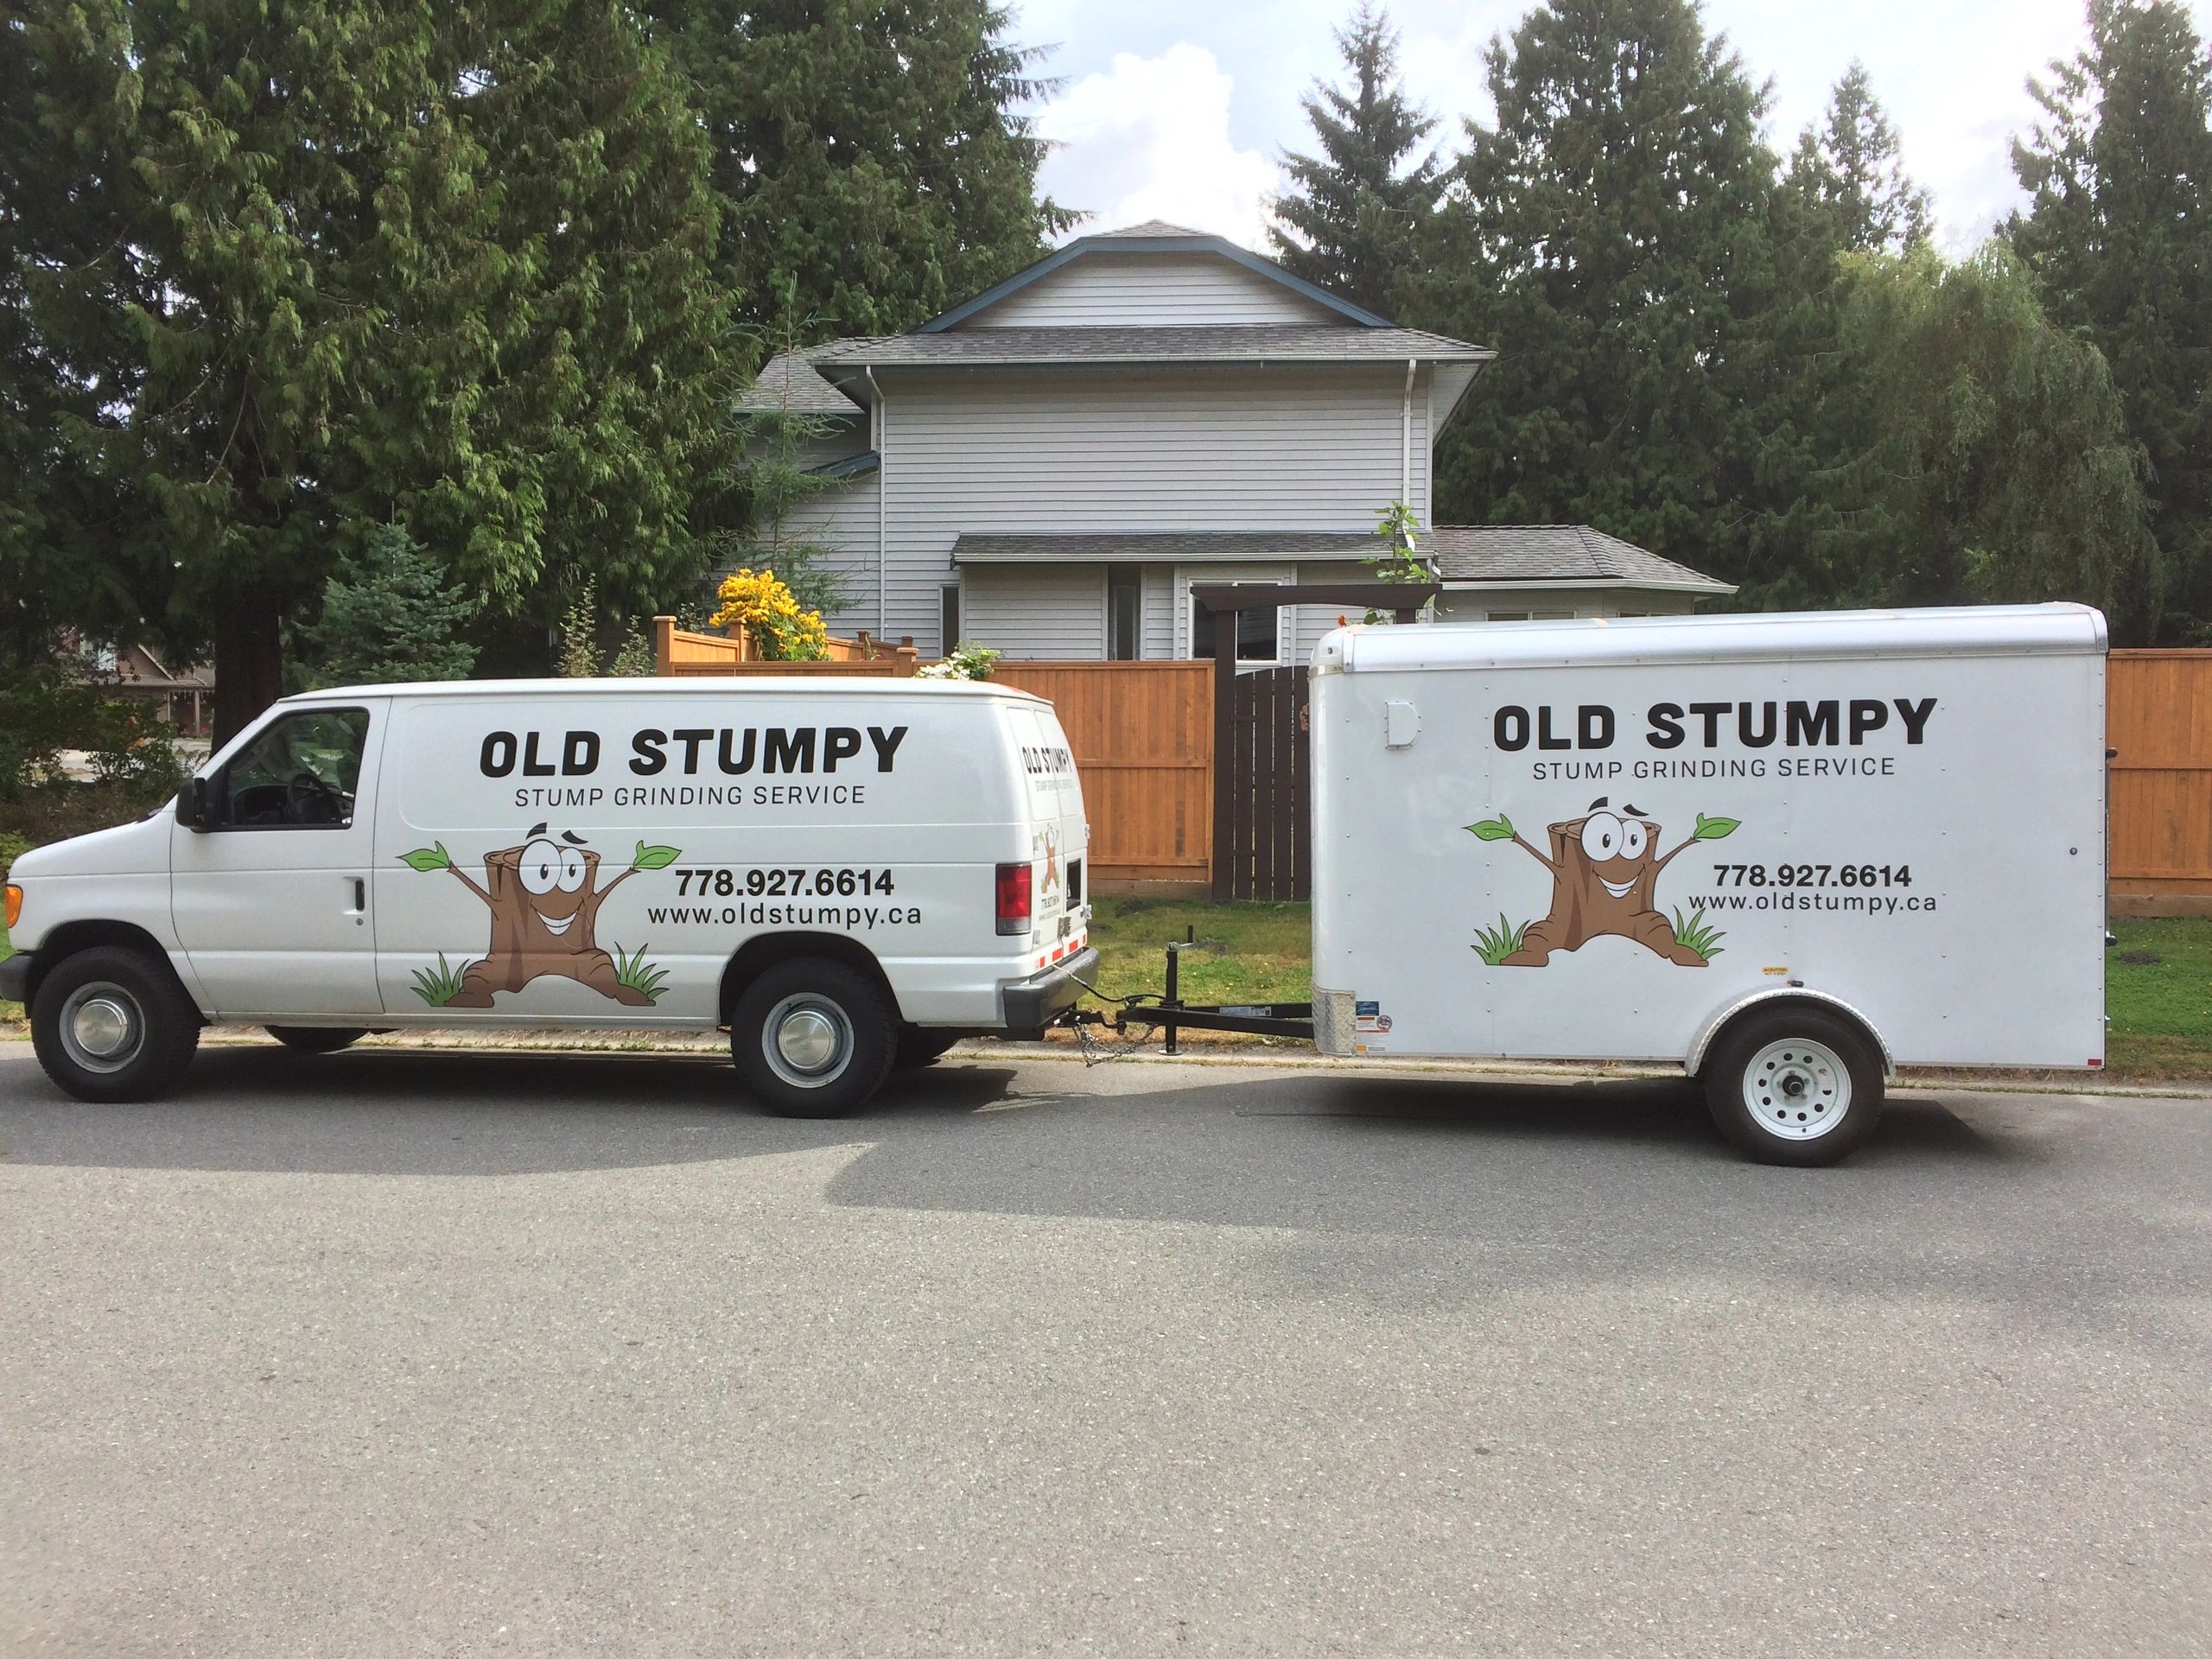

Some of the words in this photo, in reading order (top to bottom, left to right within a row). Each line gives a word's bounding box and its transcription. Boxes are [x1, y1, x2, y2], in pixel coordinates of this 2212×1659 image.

[1493, 704, 1615, 752] OLD
[1645, 697, 1938, 749] STUMPY
[480, 730, 601, 779] OLD
[628, 726, 909, 776] STUMPY
[1022, 747, 1042, 774] OLD
[1533, 761, 1623, 780] STUMP
[1634, 759, 1766, 779] GRINDING
[1778, 757, 1896, 777] SERVICE
[515, 788, 603, 807] STUMP
[614, 786, 742, 806] GRINDING
[753, 785, 865, 805] SERVICE
[675, 868, 895, 897] 778.927.6614
[1713, 864, 1912, 887] 778.927.6614
[647, 902, 922, 931] www.oldstumpy.ca
[1688, 892, 1937, 916] www.oldstumpy.ca
